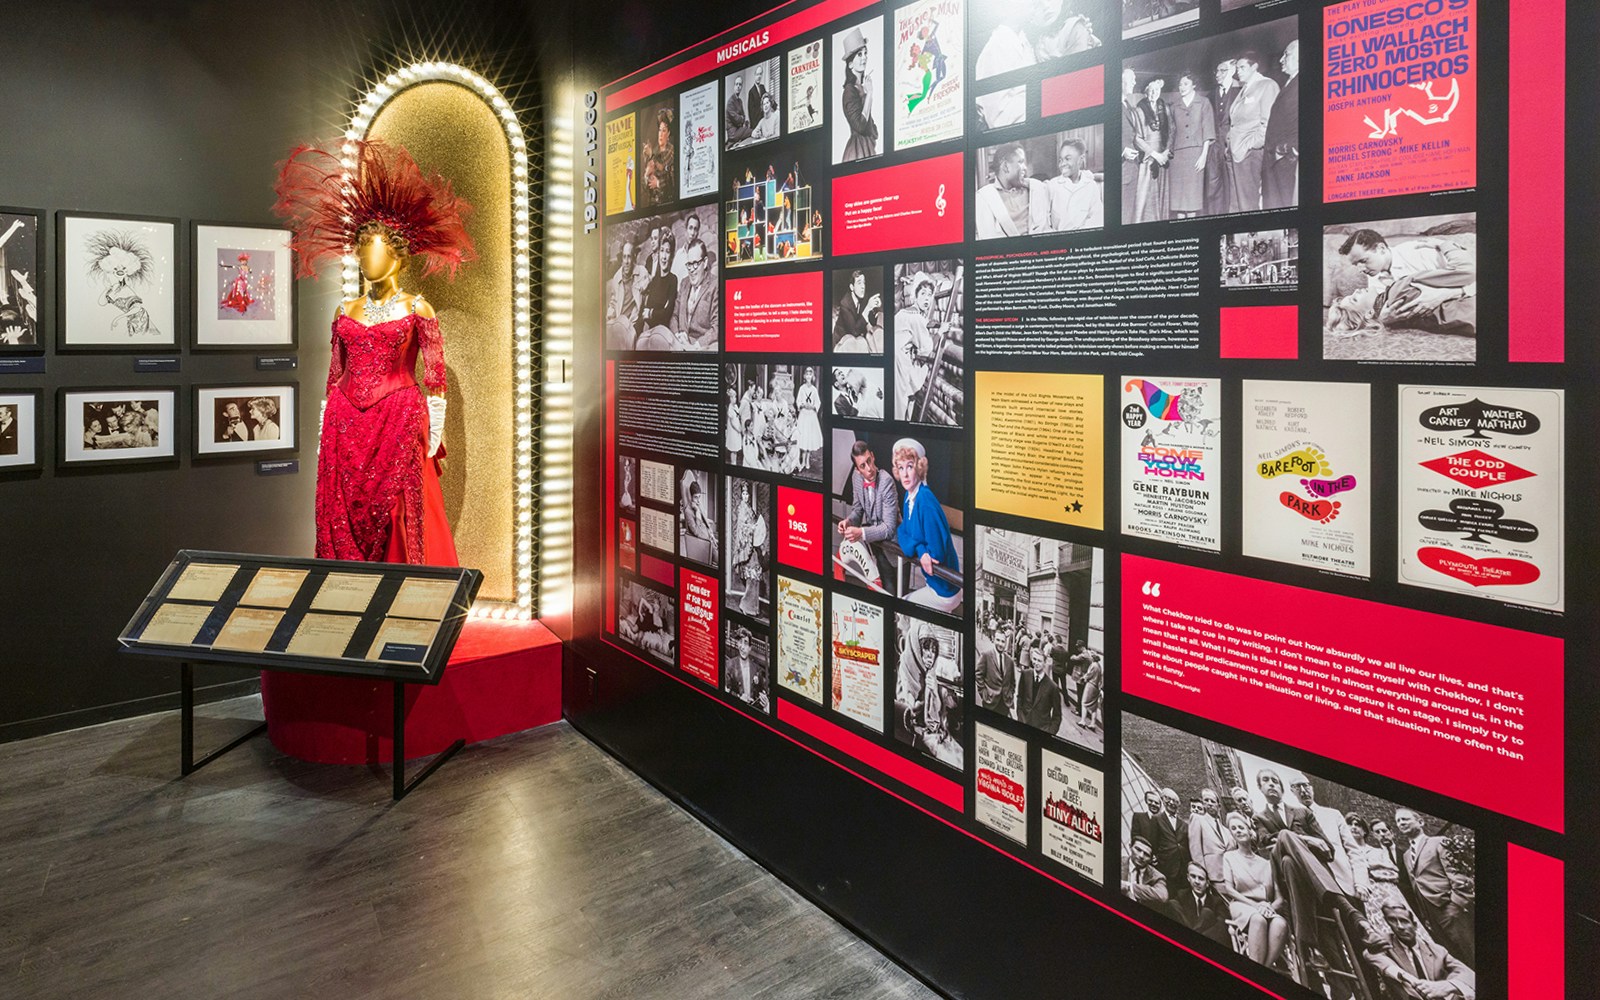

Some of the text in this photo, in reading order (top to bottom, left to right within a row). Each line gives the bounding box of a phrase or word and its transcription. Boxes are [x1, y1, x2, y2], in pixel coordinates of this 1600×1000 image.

[1344, 2, 1360, 14] PLAY
[899, 1, 960, 46] MUSIC MAN
[899, 17, 912, 31] THE
[1328, 0, 1468, 39] IONESCOS
[1328, 16, 1468, 61] ELI WALLACH
[716, 31, 770, 63] MUSICALS
[1328, 34, 1468, 77] ZERO MOSTEL
[791, 58, 820, 76] CARNIVAL
[1328, 54, 1469, 99] RHINOCEROS
[1328, 94, 1392, 112] JOSEPH ANTHONY
[1328, 137, 1403, 154] MORRIS CARNOVSKY
[1328, 139, 1450, 163] MICHAEL STRONG MIKE KELLIN
[1336, 172, 1354, 183] ANNE
[1356, 169, 1390, 180] JACKSON
[1328, 190, 1357, 200] LONGACRE
[1439, 408, 1523, 419] ART WALTER
[1429, 416, 1526, 429] CARNEY MATTHAU
[1424, 437, 1445, 446] NEIL
[1449, 438, 1490, 448] SIMON'S
[1138, 452, 1198, 465] BLOW
[1141, 446, 1203, 460] COME
[1258, 451, 1272, 460] NEIL
[1143, 460, 1201, 474] YOUR
[1261, 456, 1316, 476] BAREFOOT
[1446, 456, 1505, 469] THE ODD
[1144, 466, 1204, 481] HORN
[1449, 467, 1506, 481] COUPLE
[1133, 483, 1209, 500] GENE RAYBURN
[1313, 478, 1349, 494] IN THE
[1452, 488, 1522, 502] MIKE NICHOLS
[1287, 495, 1320, 516] PARK
[1138, 509, 1207, 524] MORRIS CARNOVSKY
[788, 520, 808, 533] 1963
[1128, 525, 1215, 544] BROOKS ATKINSON THEATRE
[1301, 539, 1354, 554] MIKE NICHOLS
[842, 545, 870, 576] CORONIA
[1302, 553, 1355, 566] BILTMORE THEATRE
[1439, 559, 1511, 576] PLYMOUTH THEATRE
[700, 587, 711, 598] GET
[692, 595, 701, 605] FOR
[702, 599, 712, 609] YOU
[684, 602, 713, 621] WHOLESALE
[788, 610, 811, 624] Camelot
[838, 646, 877, 661] SKYSCRAPER
[1142, 603, 1161, 613] What
[1162, 608, 1193, 620] Chekhov
[1194, 616, 1212, 625] tried
[1235, 626, 1251, 634] was
[1263, 633, 1285, 643] point
[1287, 639, 1302, 647] out
[1304, 641, 1323, 652] how
[1325, 647, 1365, 663] absurdly
[1367, 657, 1381, 666] we
[1383, 661, 1395, 669] all
[1398, 663, 1415, 674] live
[1418, 670, 1436, 678] our
[1438, 673, 1464, 686] lives,
[1467, 681, 1488, 692] and
[1491, 686, 1523, 700] that's
[1162, 664, 1184, 677] funny.
[1142, 649, 1160, 658] write
[1161, 654, 1182, 664] about
[1184, 660, 1209, 671] people
[1210, 668, 1237, 679] caught
[1239, 674, 1247, 682] in
[1249, 677, 1263, 686] the
[1264, 682, 1301, 697] situation
[1314, 695, 1340, 709] living,
[1343, 704, 1361, 714] and
[1363, 709, 1383, 721] that
[1386, 716, 1430, 734] situation
[1433, 730, 1461, 742] more
[1463, 738, 1493, 751] often
[1496, 746, 1523, 760] than
[1047, 768, 1068, 785] GIELGUD
[1078, 780, 1098, 797] WORTH
[1048, 804, 1070, 824] TINY
[1071, 815, 1098, 838] ALICE
[1050, 848, 1094, 876] BILLY ROSE THEATRE
